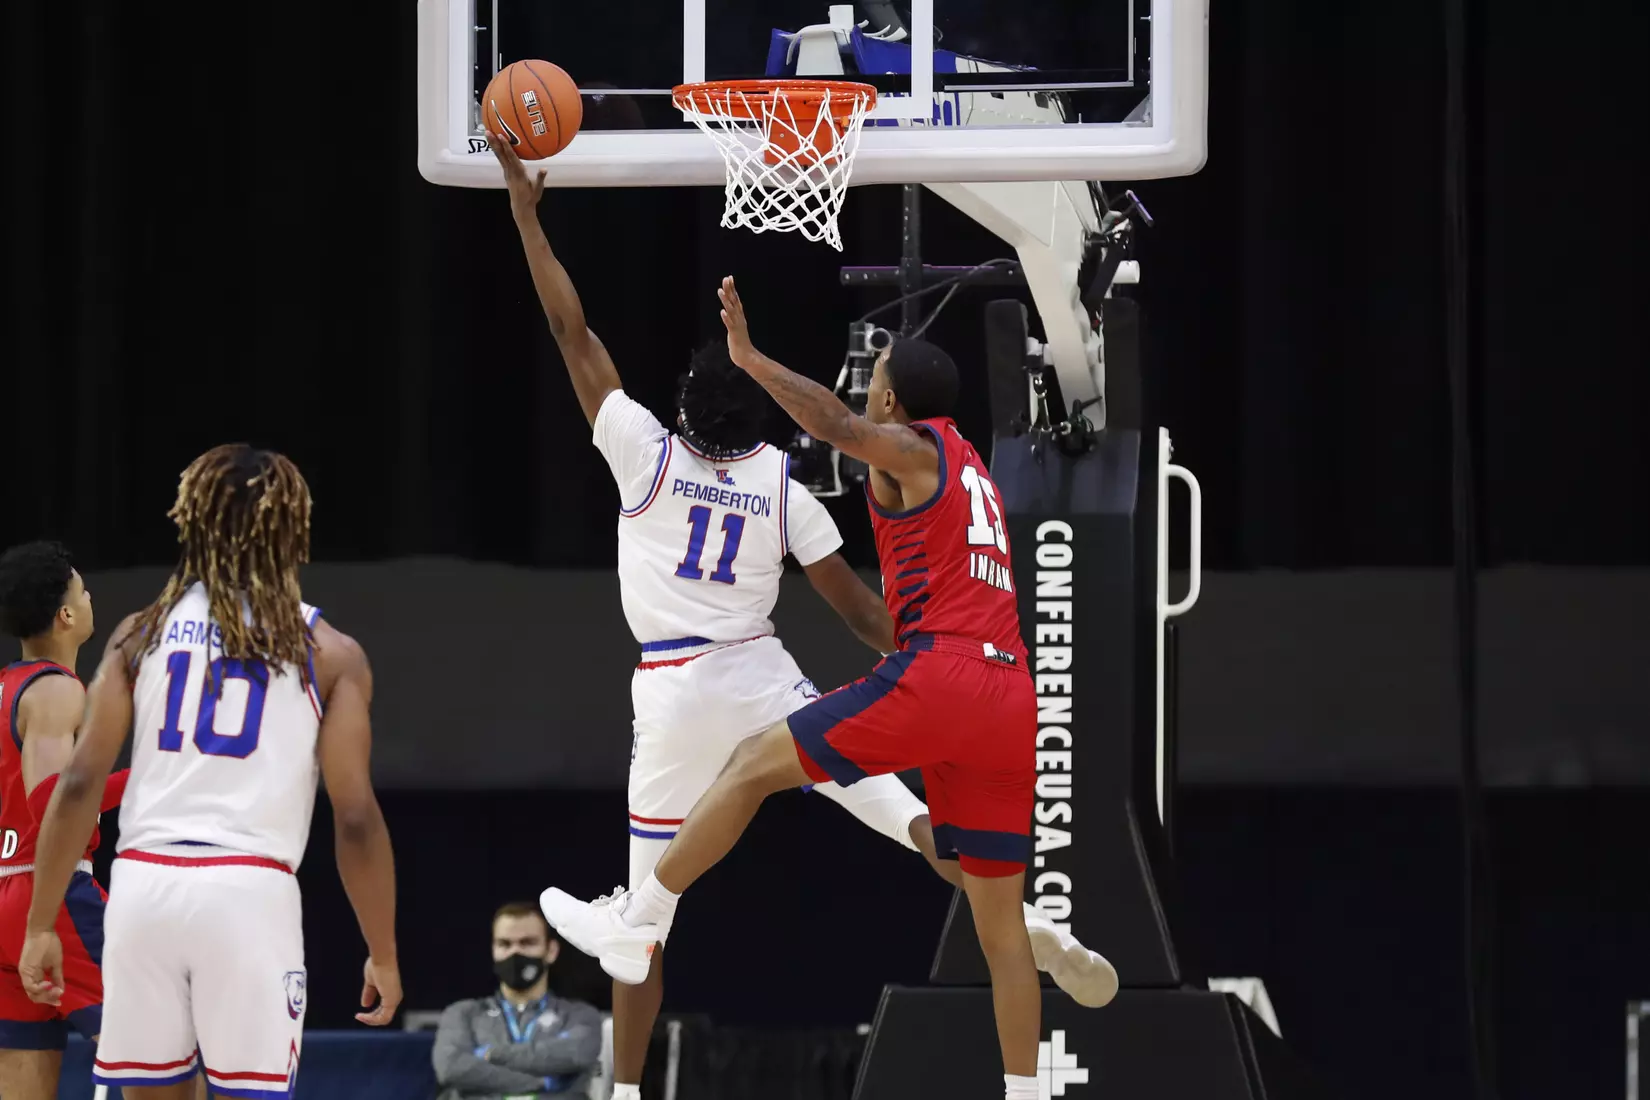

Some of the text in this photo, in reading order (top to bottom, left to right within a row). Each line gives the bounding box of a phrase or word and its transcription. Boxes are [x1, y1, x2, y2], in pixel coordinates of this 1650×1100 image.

[672, 478, 771, 517] PEMBERTON
[674, 504, 746, 585] 11
[165, 620, 224, 648] ARMS
[158, 650, 270, 760] 10
